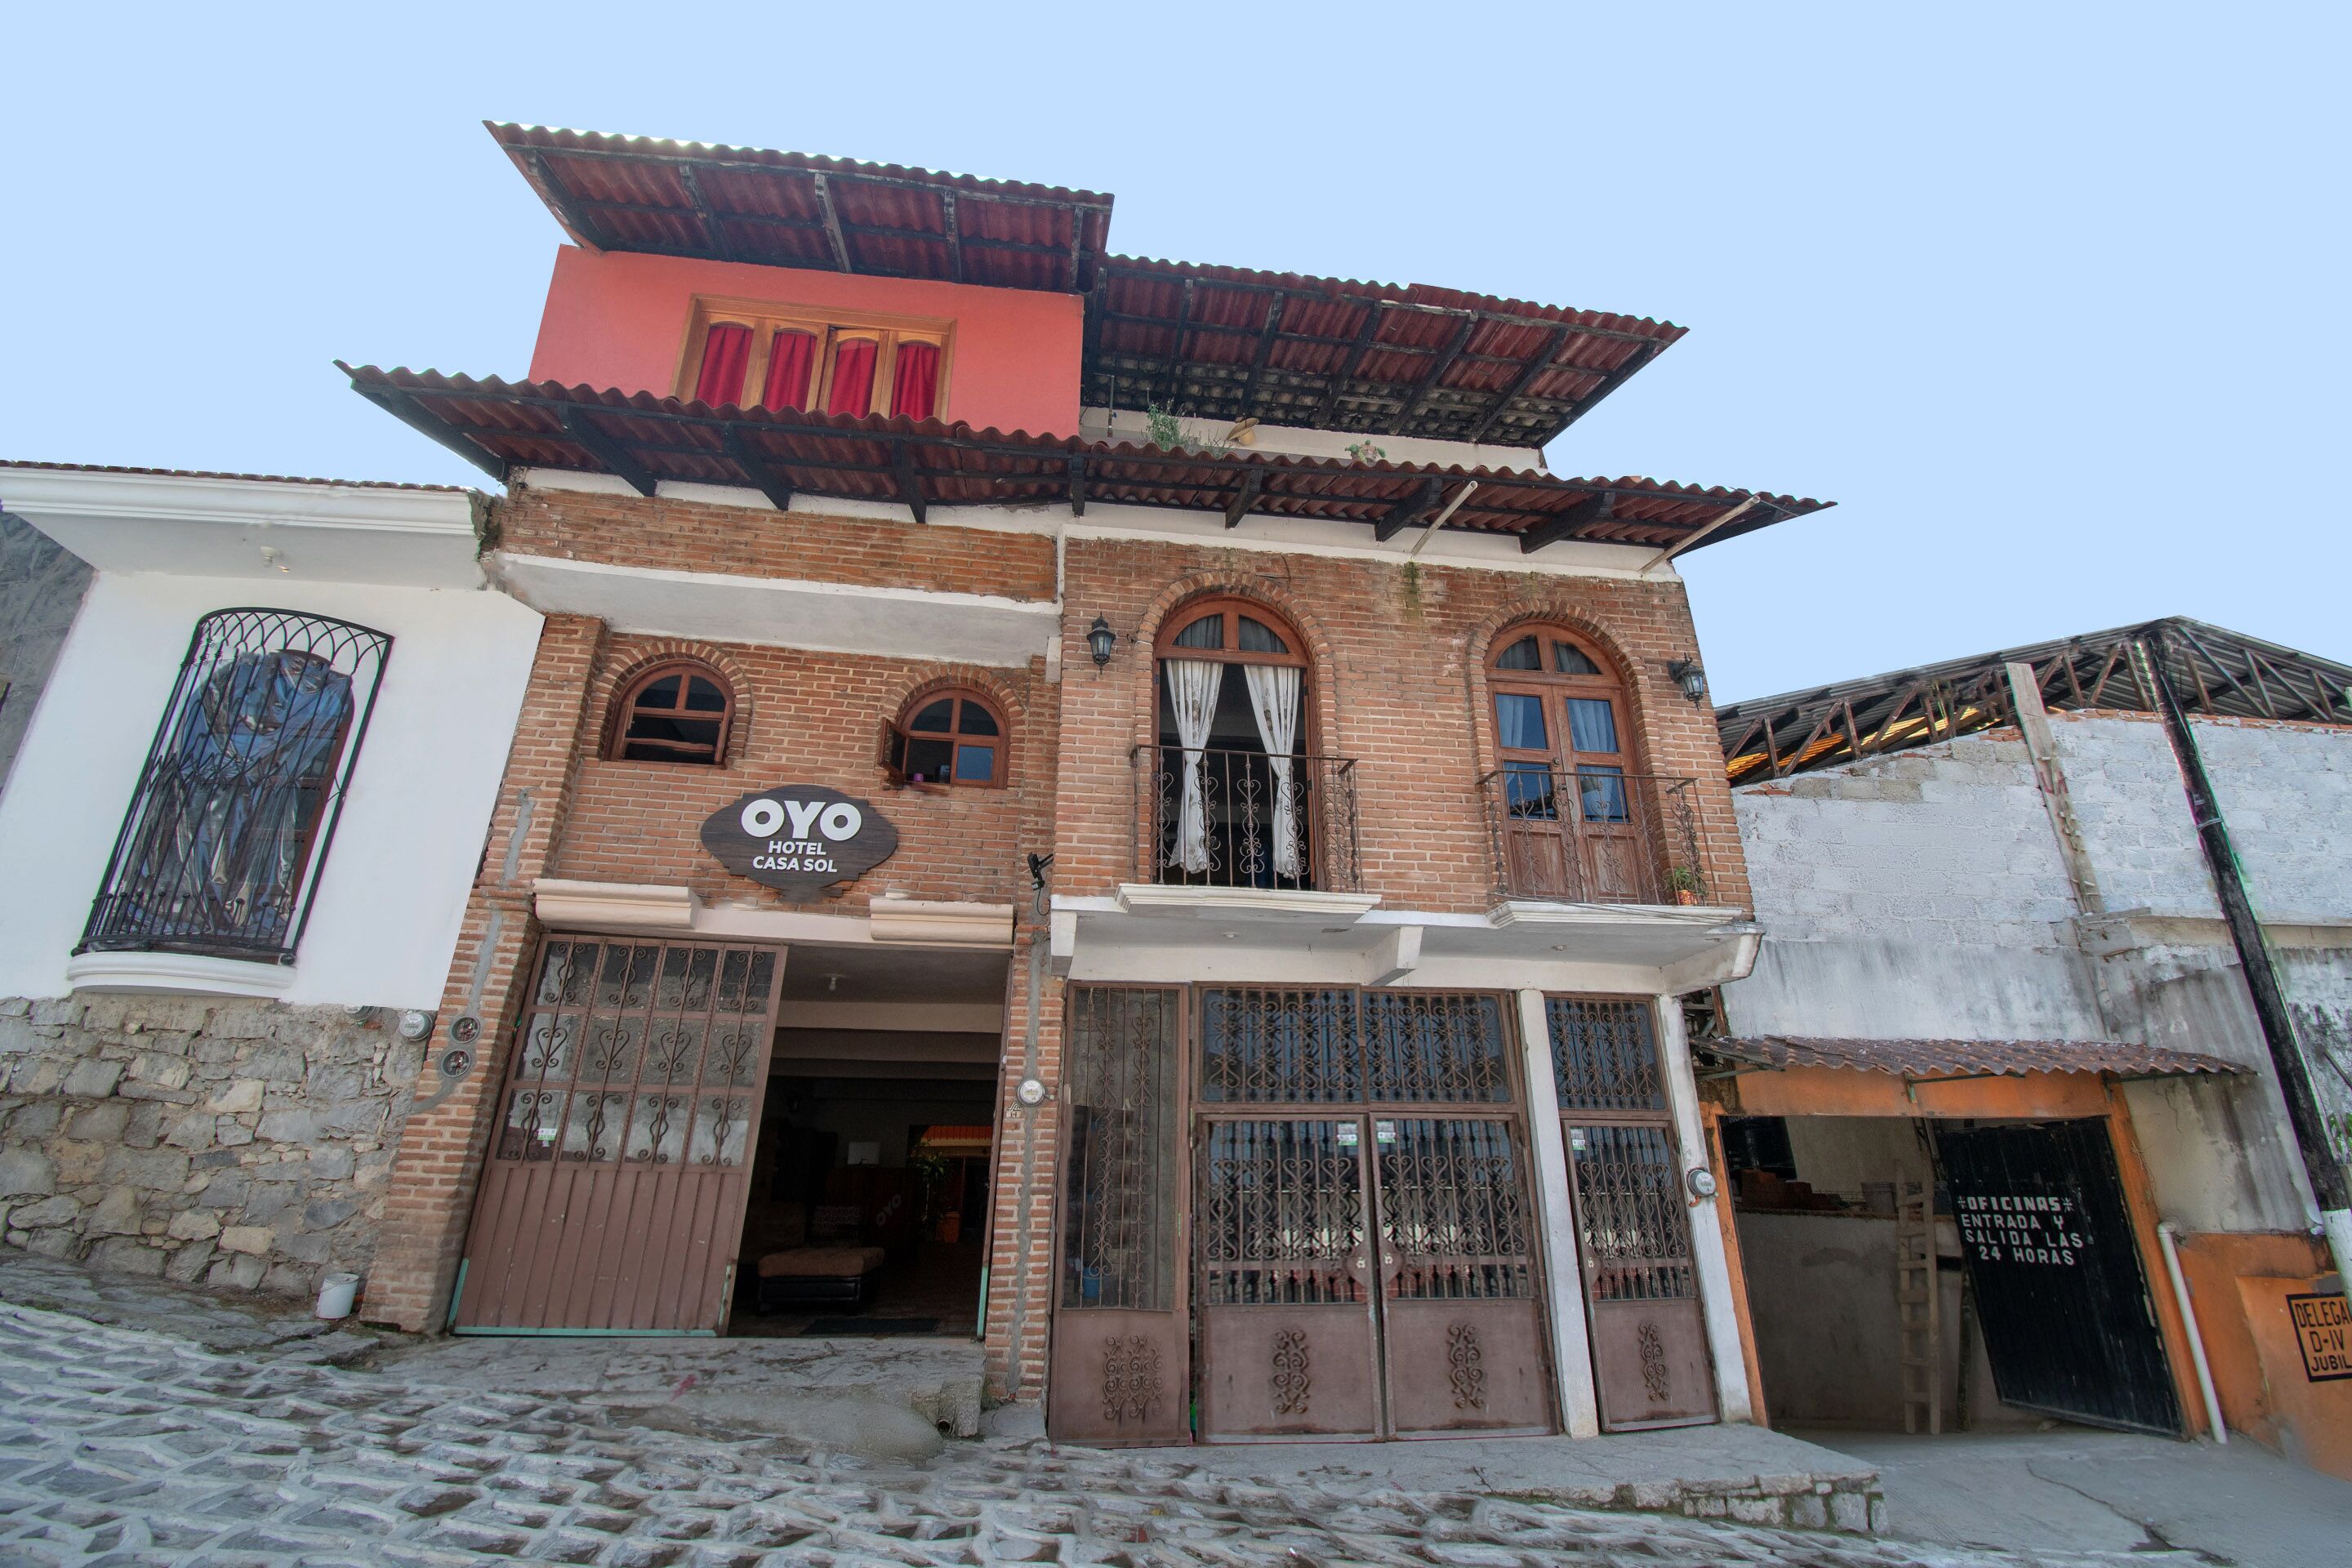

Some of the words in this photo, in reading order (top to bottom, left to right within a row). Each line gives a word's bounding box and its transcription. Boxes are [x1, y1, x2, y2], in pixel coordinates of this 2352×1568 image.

[741, 799, 862, 841] OYO
[768, 840, 826, 856] HOTEL
[752, 856, 800, 871] CASA
[803, 858, 838, 873] SOL
[875, 1194, 902, 1226] OYO
[1961, 1214, 2041, 1229] ENTRADA
[2052, 1215, 2064, 1230] Y
[1966, 1229, 2033, 1246] SALIDA
[2045, 1232, 2083, 1249] LAS
[1979, 1245, 2001, 1261] 24
[2013, 1247, 2075, 1266] HORAS
[2295, 1300, 2352, 1328] DELEGA
